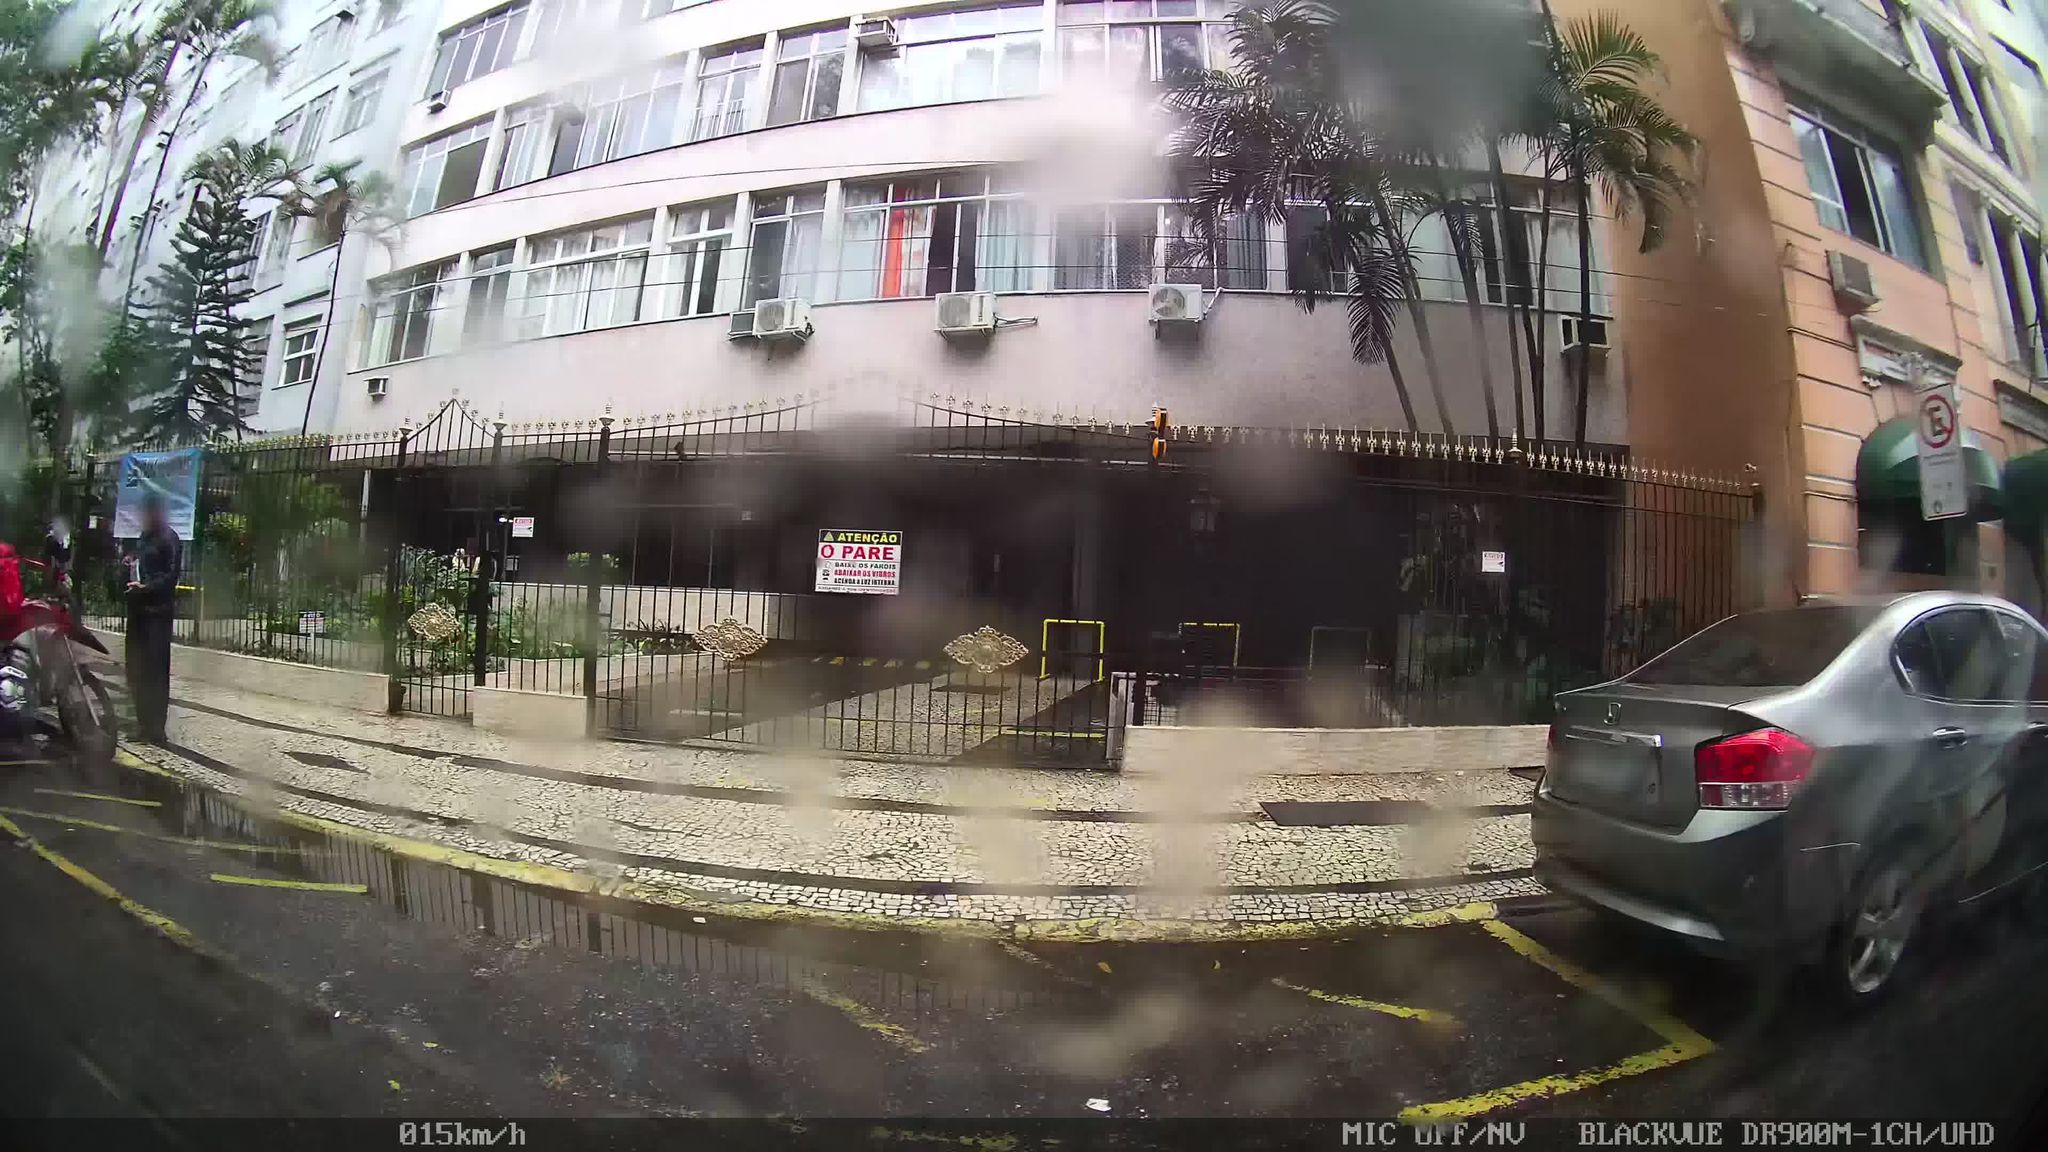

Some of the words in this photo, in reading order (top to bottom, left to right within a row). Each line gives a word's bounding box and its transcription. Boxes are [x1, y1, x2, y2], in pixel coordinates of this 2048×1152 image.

[837, 533, 897, 544] ATENÇÃO
[821, 544, 834, 558] O
[842, 546, 894, 560] PARE
